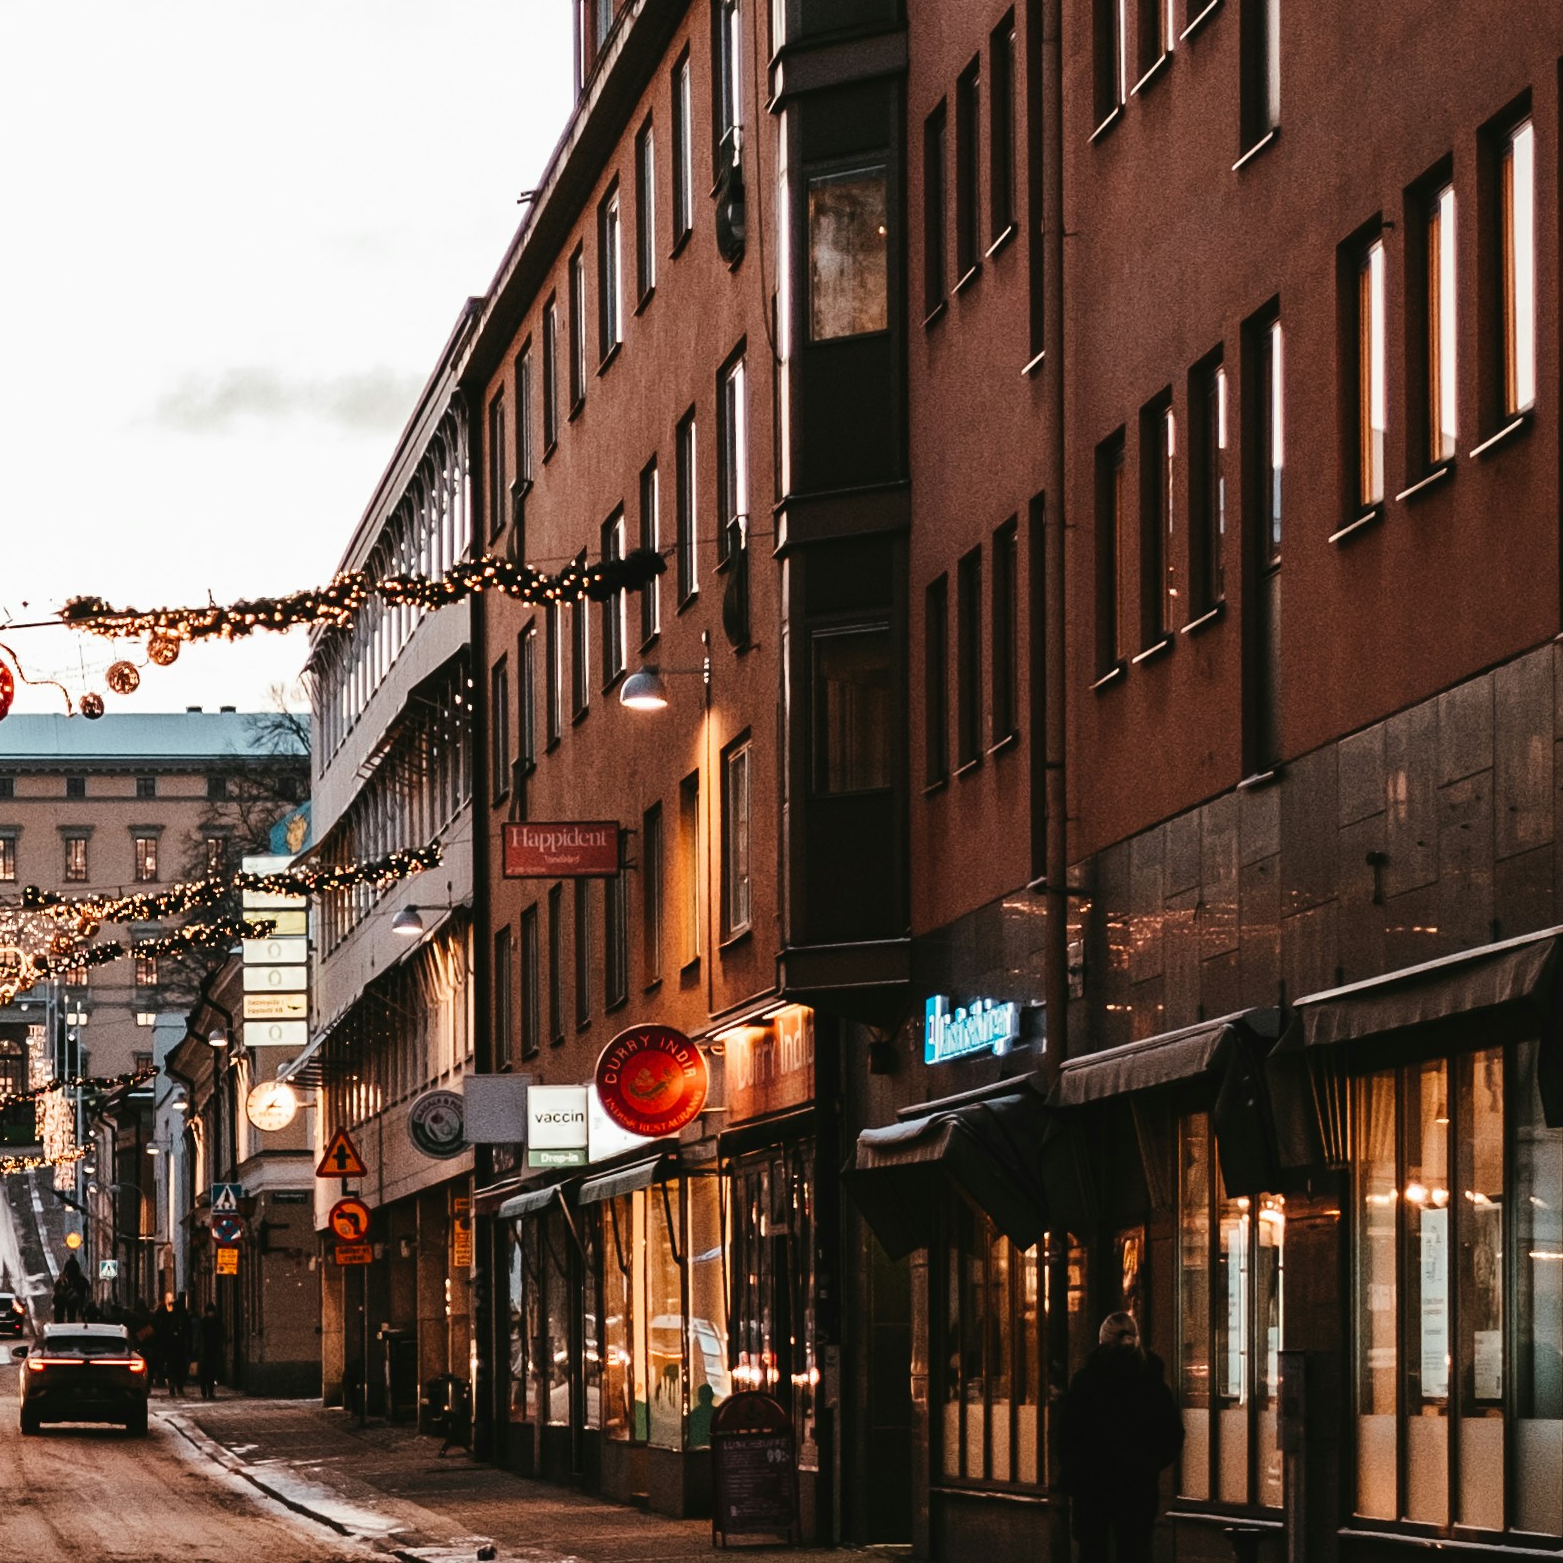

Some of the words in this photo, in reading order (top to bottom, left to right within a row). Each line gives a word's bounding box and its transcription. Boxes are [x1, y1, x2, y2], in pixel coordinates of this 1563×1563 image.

[511, 827, 607, 853] Happident
[604, 1035, 650, 1084] CURRY
[659, 1037, 697, 1078] INDIA
[535, 1109, 584, 1124] vaccin
[540, 1152, 579, 1164] Drop-in
